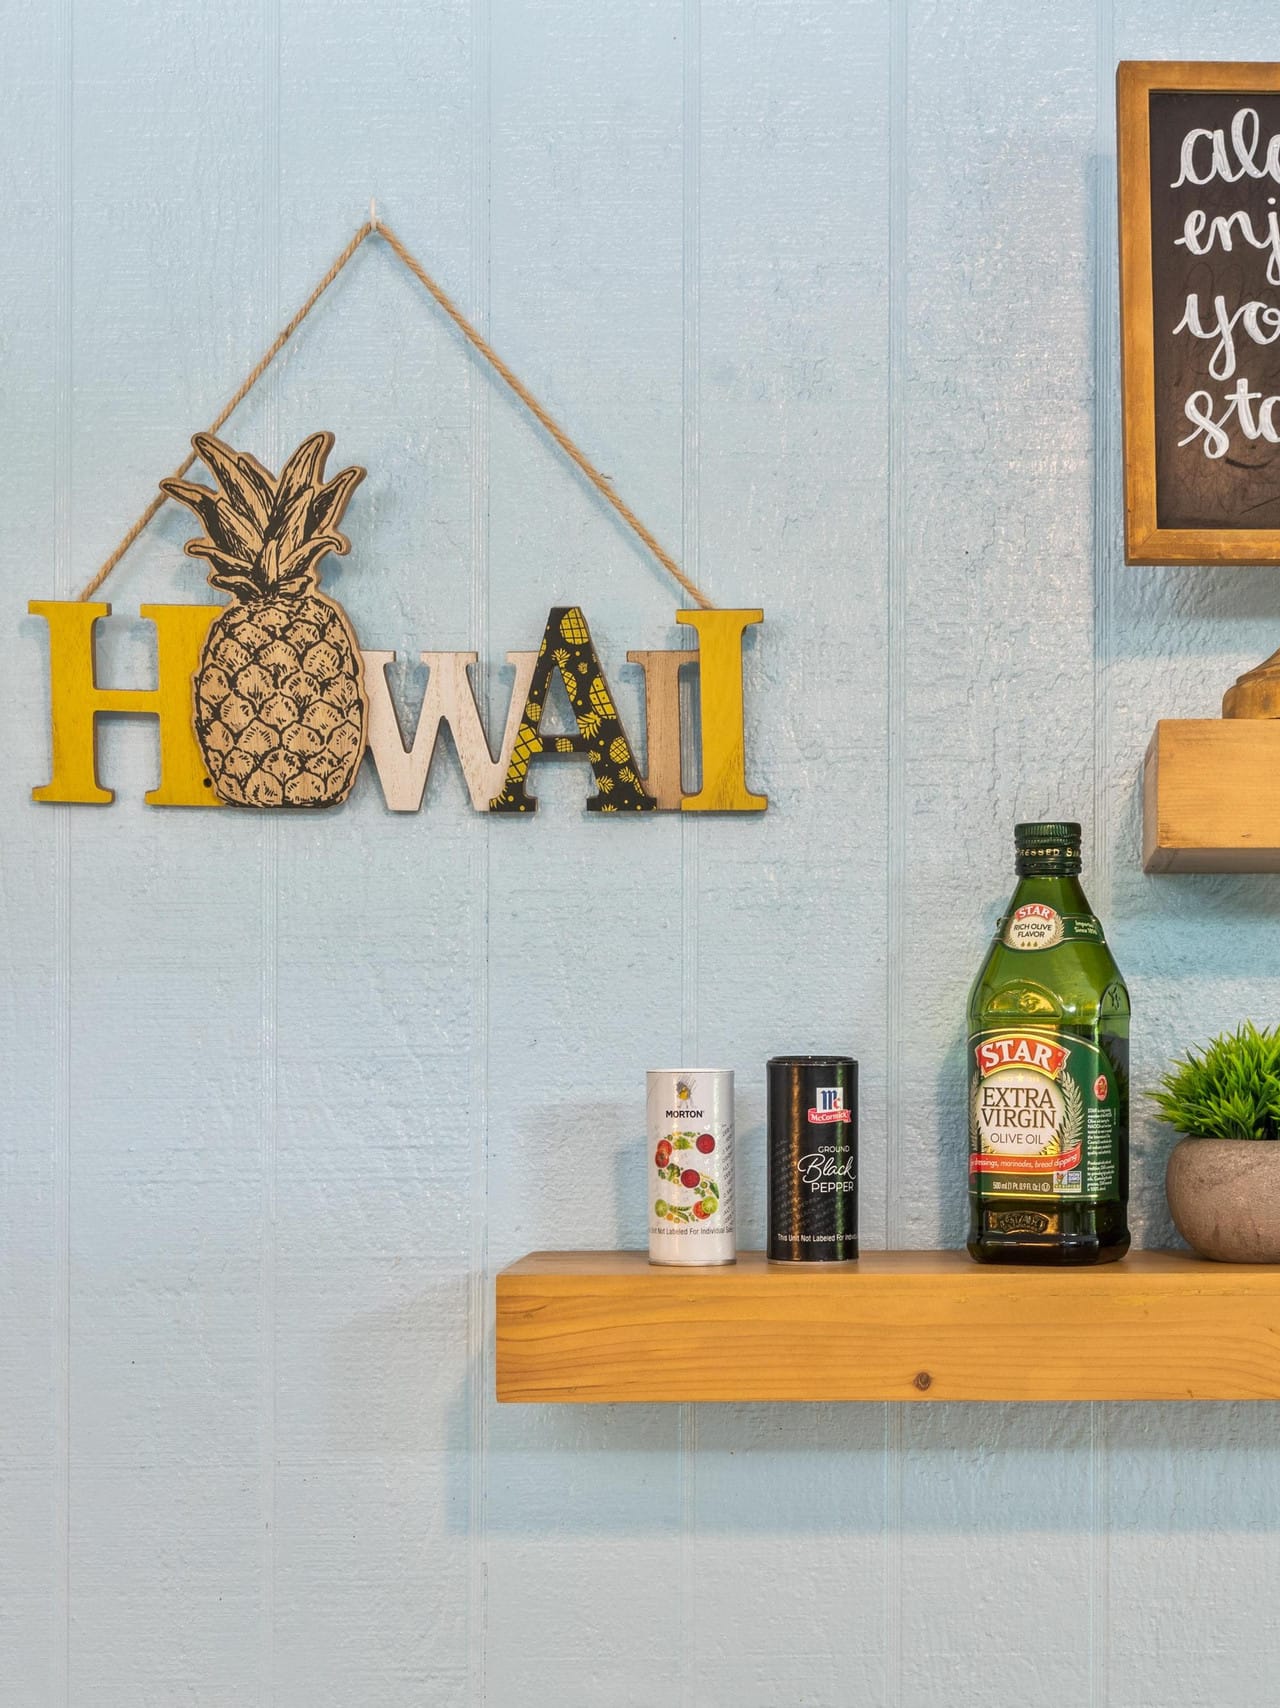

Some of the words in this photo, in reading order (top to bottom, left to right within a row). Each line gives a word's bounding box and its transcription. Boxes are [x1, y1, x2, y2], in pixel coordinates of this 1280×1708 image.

[1019, 905, 1050, 919] STAR
[1014, 923, 1030, 931] RICH
[1030, 923, 1053, 931] OLIVE
[981, 1039, 1052, 1072] STAR
[982, 1086, 1056, 1109] EXTRA
[665, 1110, 703, 1118] MORTON
[810, 1111, 847, 1121] McCormick
[981, 1107, 1057, 1129] VIRGIN
[990, 1132, 1023, 1144] OLIVE
[1025, 1133, 1044, 1145] OIL
[817, 1145, 850, 1153] GROUND
[797, 1153, 857, 1183] Black
[811, 1181, 854, 1193] PEPPER
[689, 1227, 699, 1235] For
[800, 1234, 811, 1242] Not
[812, 1233, 836, 1241] Labeled
